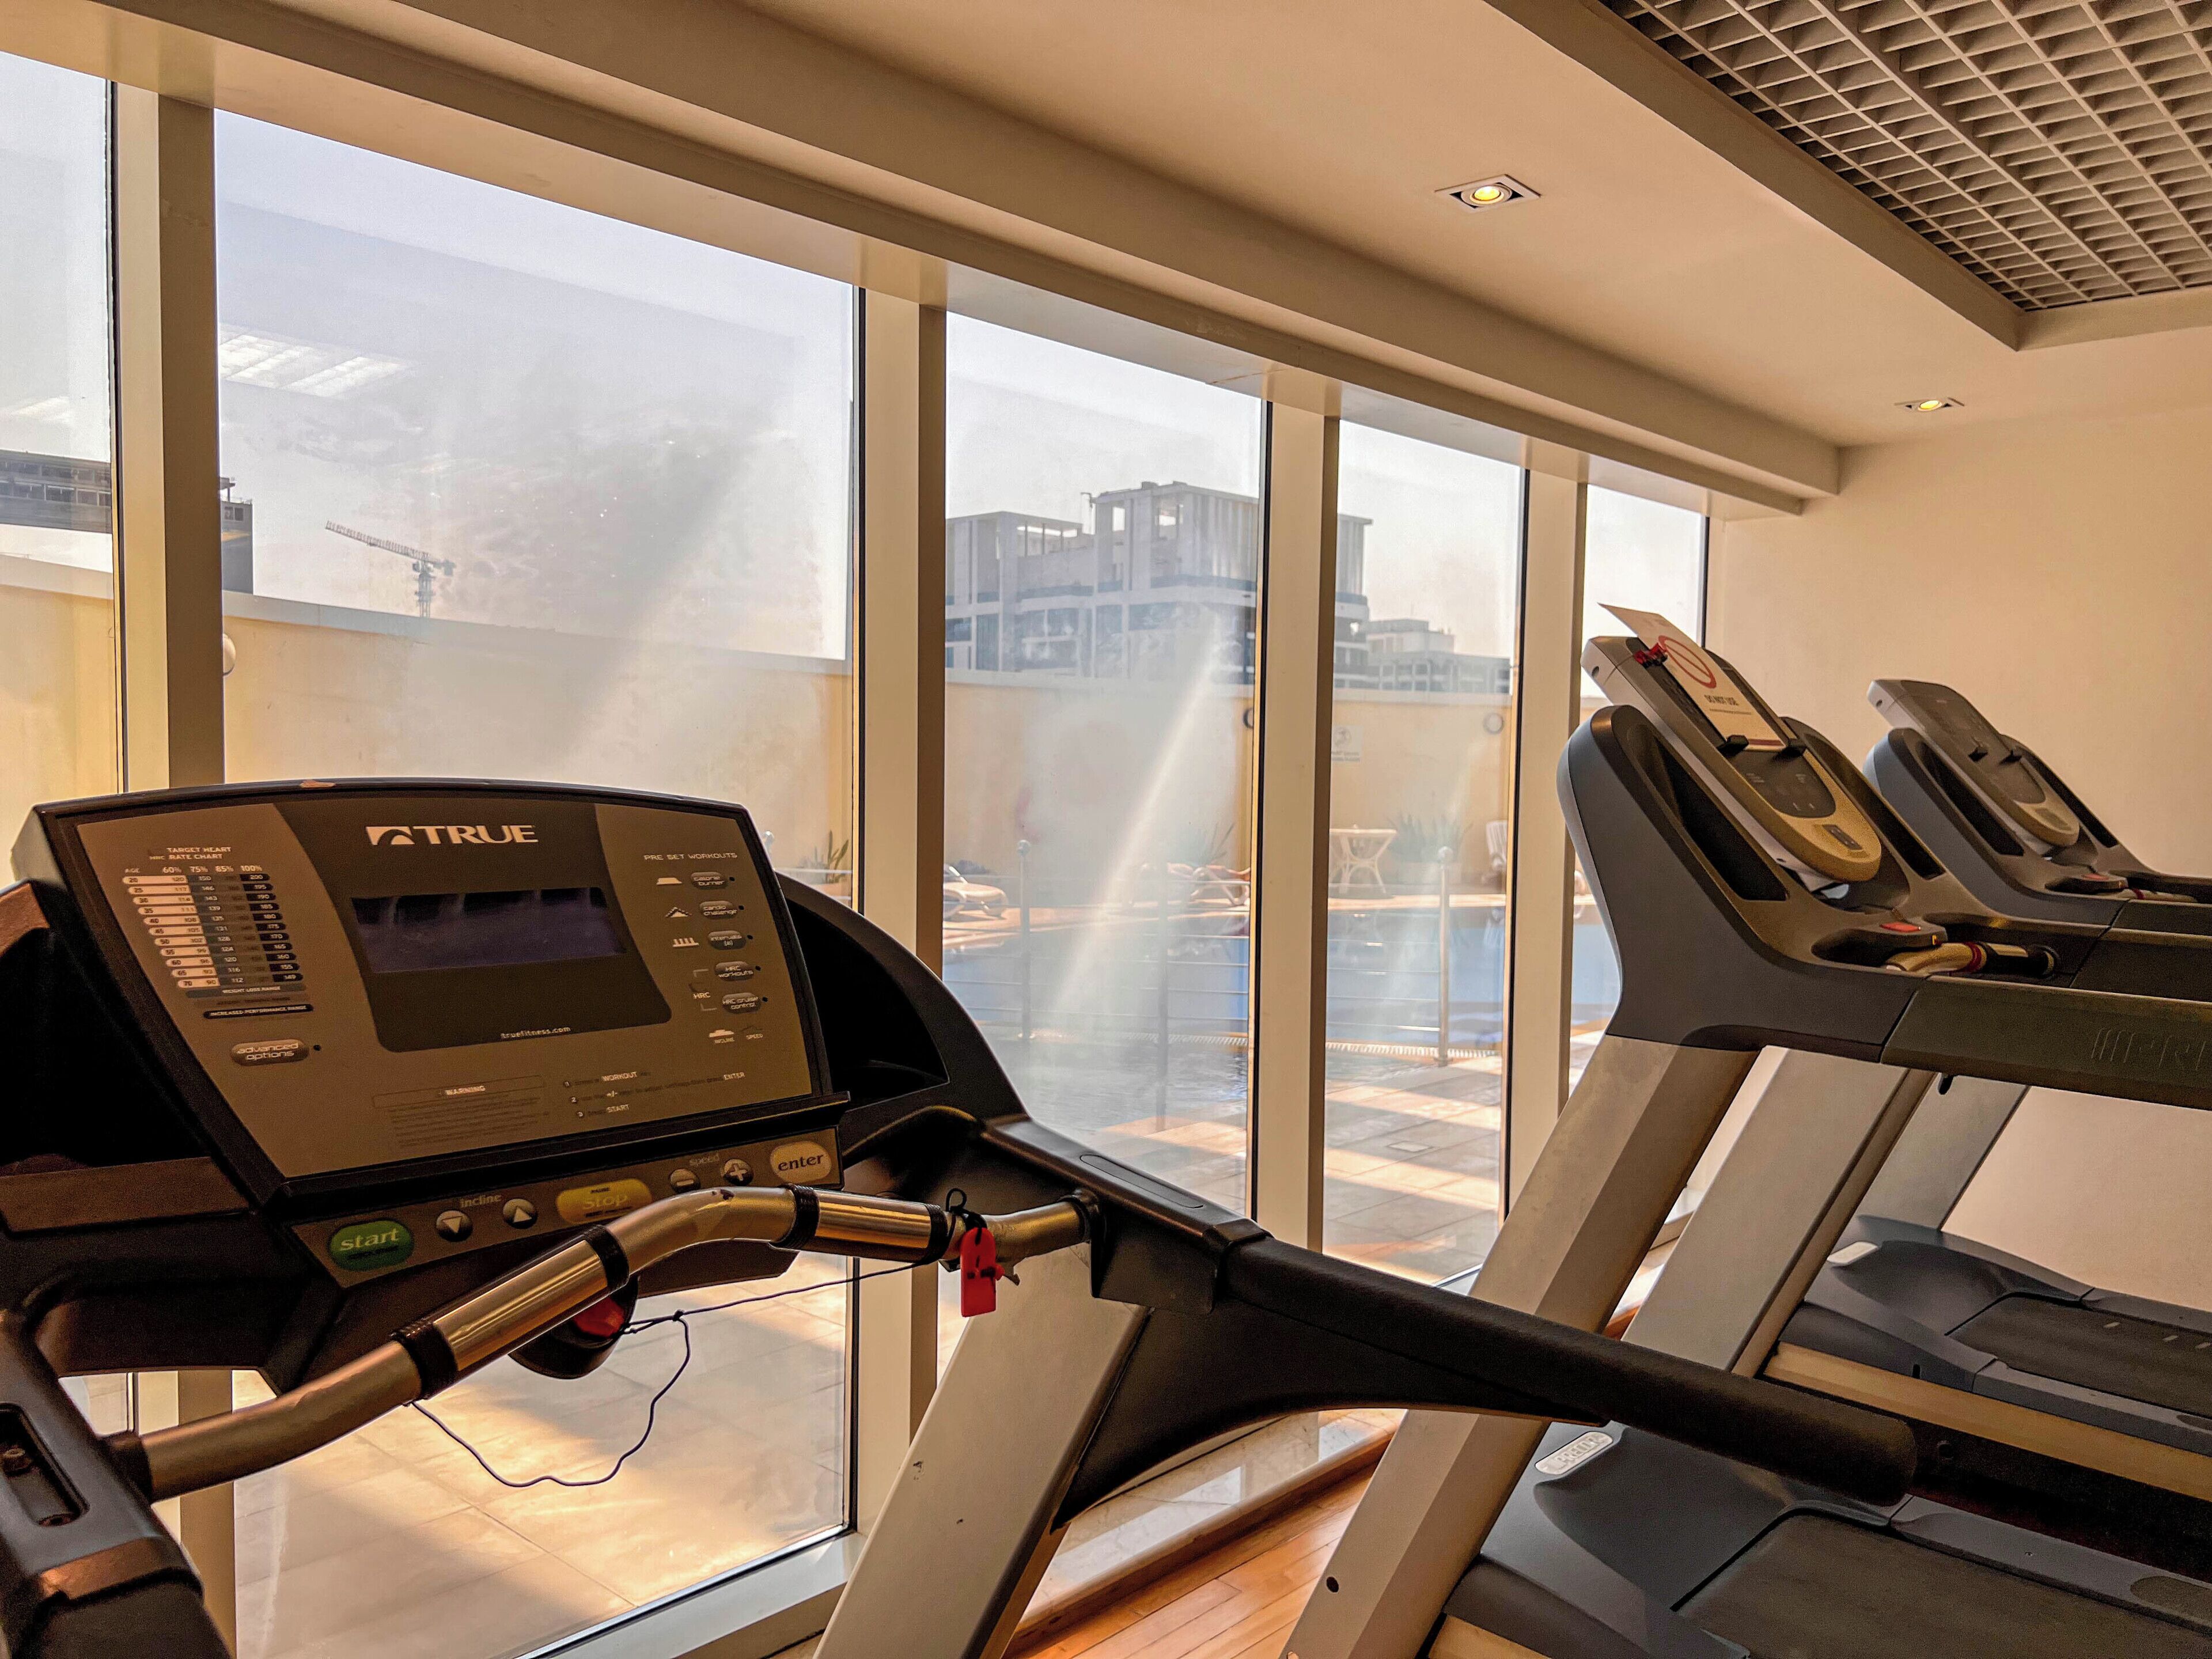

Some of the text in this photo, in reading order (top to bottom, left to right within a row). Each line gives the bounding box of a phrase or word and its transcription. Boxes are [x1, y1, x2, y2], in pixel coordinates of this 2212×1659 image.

[412, 825, 539, 844] TRUE
[501, 1027, 571, 1039] truefitness.com
[237, 1043, 298, 1054] advanced
[245, 1050, 294, 1060] options
[601, 1071, 638, 1081] WORKOUT
[724, 1071, 745, 1081] ENTER
[445, 1085, 486, 1095] WARNING
[606, 1104, 630, 1113] START
[690, 1153, 719, 1166] speed
[778, 1153, 824, 1172] enter
[460, 1194, 502, 1208] incline
[583, 1194, 628, 1209] stop
[340, 1228, 399, 1251] start
